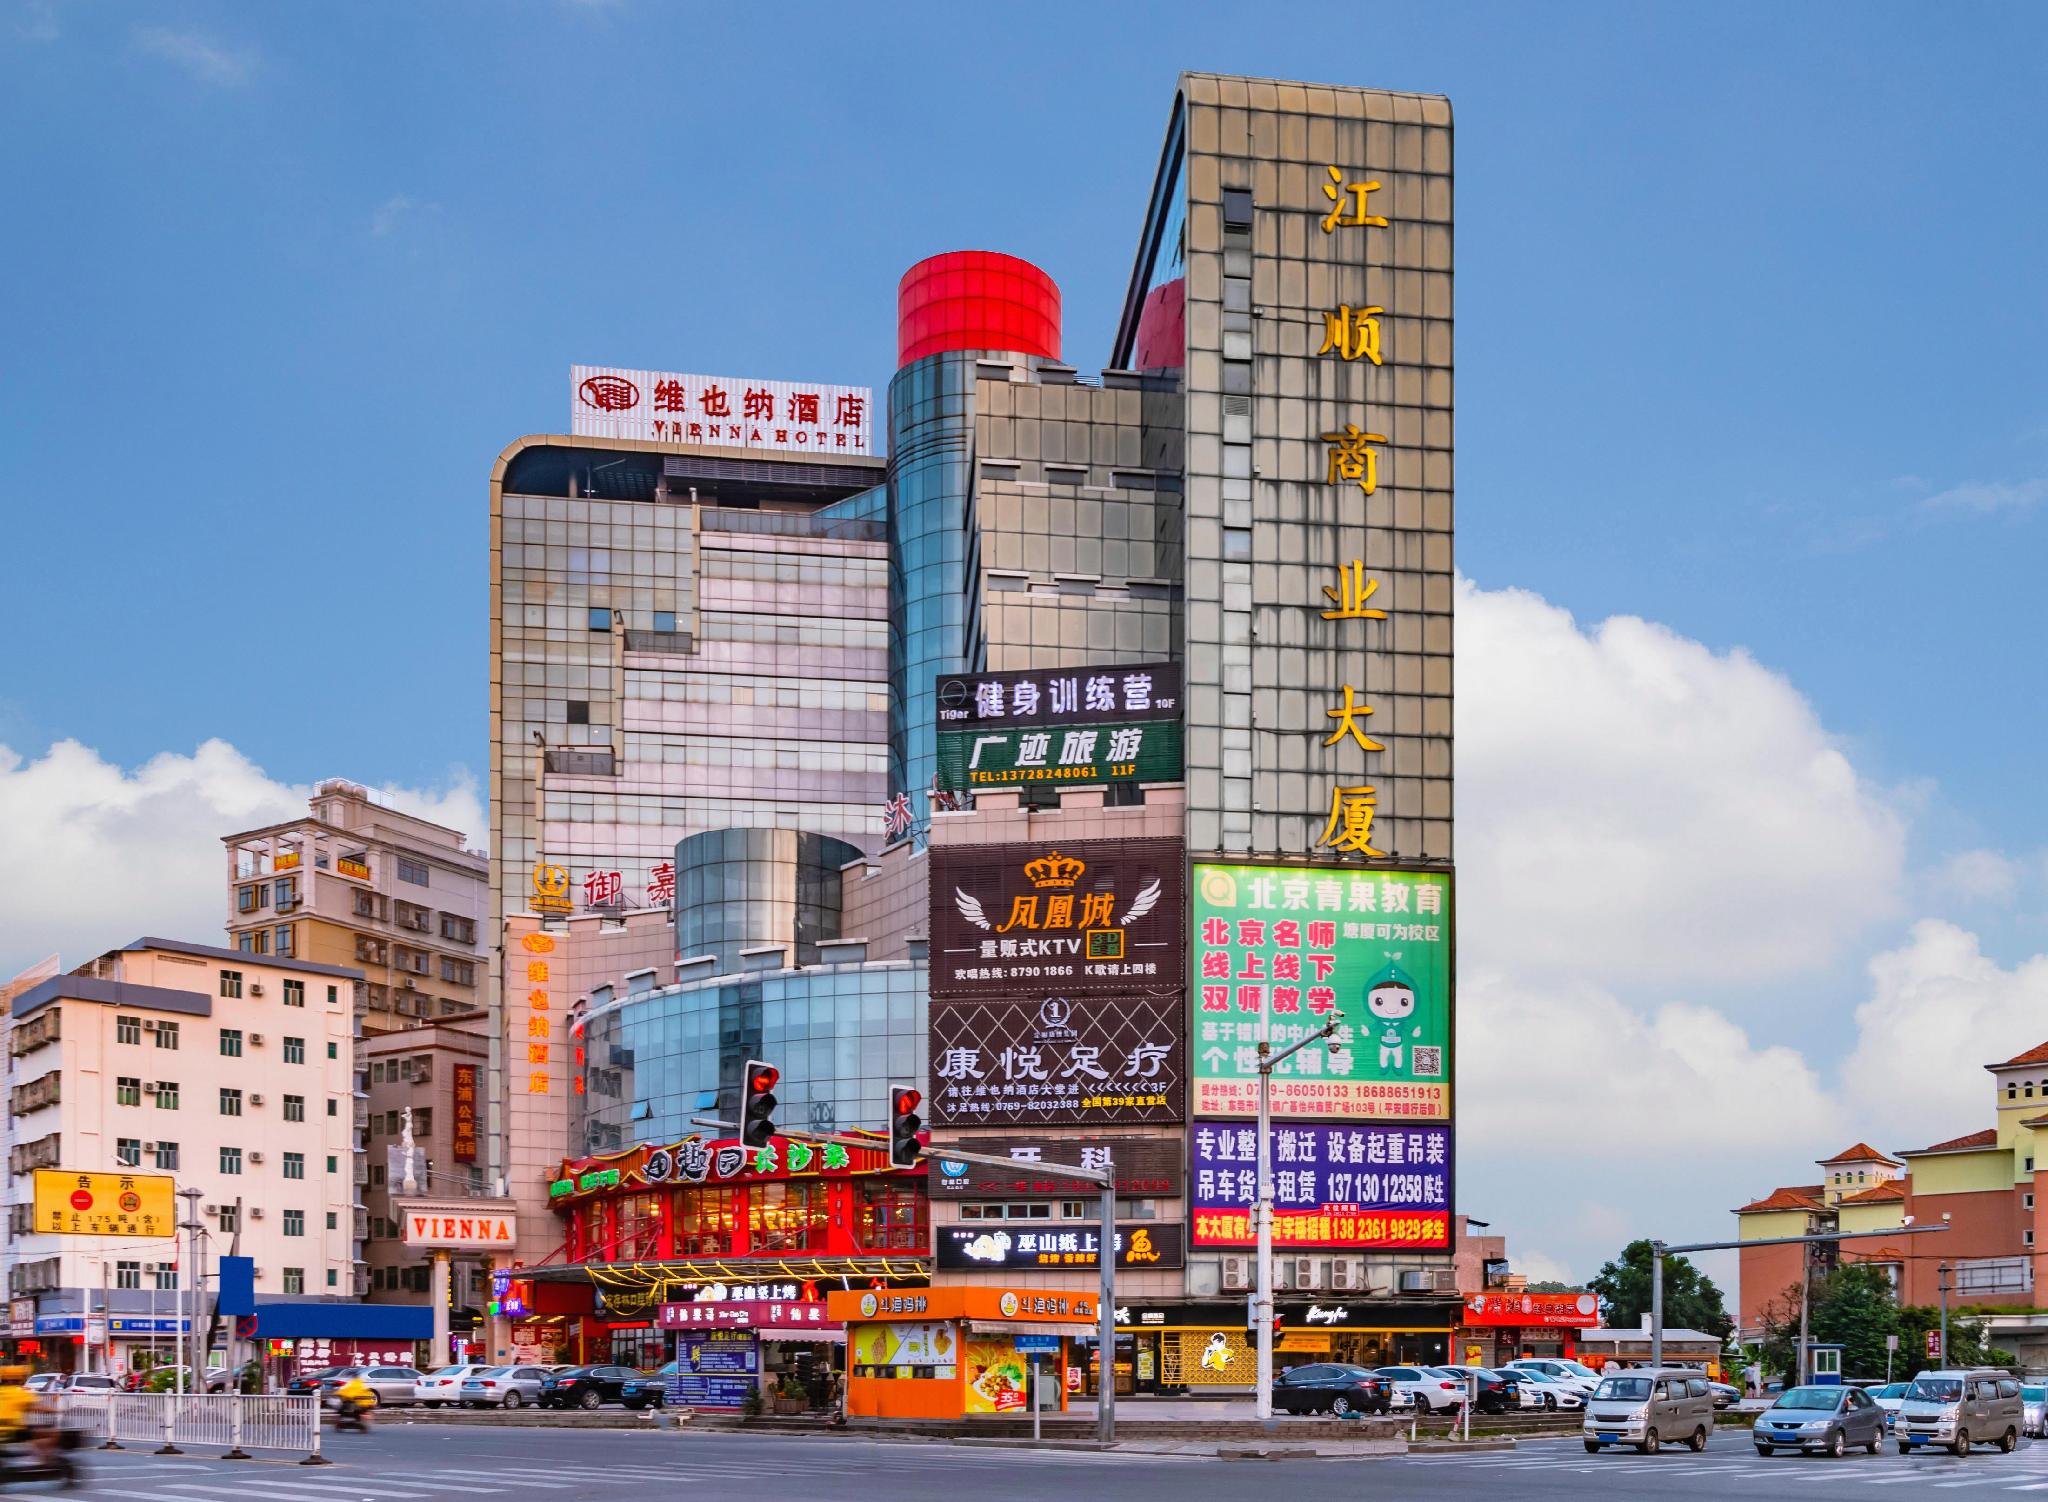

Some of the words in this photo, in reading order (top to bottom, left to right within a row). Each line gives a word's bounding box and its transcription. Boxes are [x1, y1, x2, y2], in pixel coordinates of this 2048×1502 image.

[654, 379, 864, 428] 维也纳酒店
[652, 420, 763, 441] VIENNA
[774, 429, 865, 448] HOTEL
[1316, 164, 1388, 857] 江顺商业大厦
[975, 673, 1152, 718] 健身训练营
[1155, 698, 1175, 709] 10F
[939, 709, 969, 720] Tiger
[969, 728, 1143, 769] 广迹旅游
[970, 766, 1098, 783] TEL:13728248061
[1111, 764, 1136, 776] 11F
[882, 791, 914, 840] 沐
[1247, 877, 1443, 915] 北京青果教育
[996, 892, 1115, 933] 凤凰城
[979, 938, 1081, 959] 量贩式KTV
[1201, 917, 1337, 949] 北京名师
[1010, 966, 1040, 977] 8790
[1043, 965, 1073, 976] 1866
[1084, 962, 1157, 976] K歌请上四楼
[1201, 951, 1337, 982] 线上线下
[1201, 984, 1337, 1014] 双师教学
[527, 960, 550, 1094] 维也纳酒店
[937, 1042, 1171, 1080] 康悦足疗
[947, 1082, 1080, 1098] 请往维也纳酒店大堂进
[1151, 1081, 1167, 1093] 3F
[1246, 1083, 1348, 1098] 079-86050133
[1356, 1085, 1440, 1099] 18688651913
[1196, 1127, 1317, 1162] 专业整搬迁
[1327, 1131, 1445, 1165] 设备起重吊装
[77, 1175, 134, 1190] 告示
[1198, 1168, 1317, 1203] 吊车货租赁
[1327, 1172, 1352, 1202] 137
[1355, 1173, 1379, 1202] 130
[1382, 1173, 1422, 1203] 12358
[413, 1217, 510, 1241] VIENNA
[1333, 1218, 1355, 1240] 138
[1358, 1218, 1386, 1240] 2361
[1390, 1218, 1421, 1240] 9829
